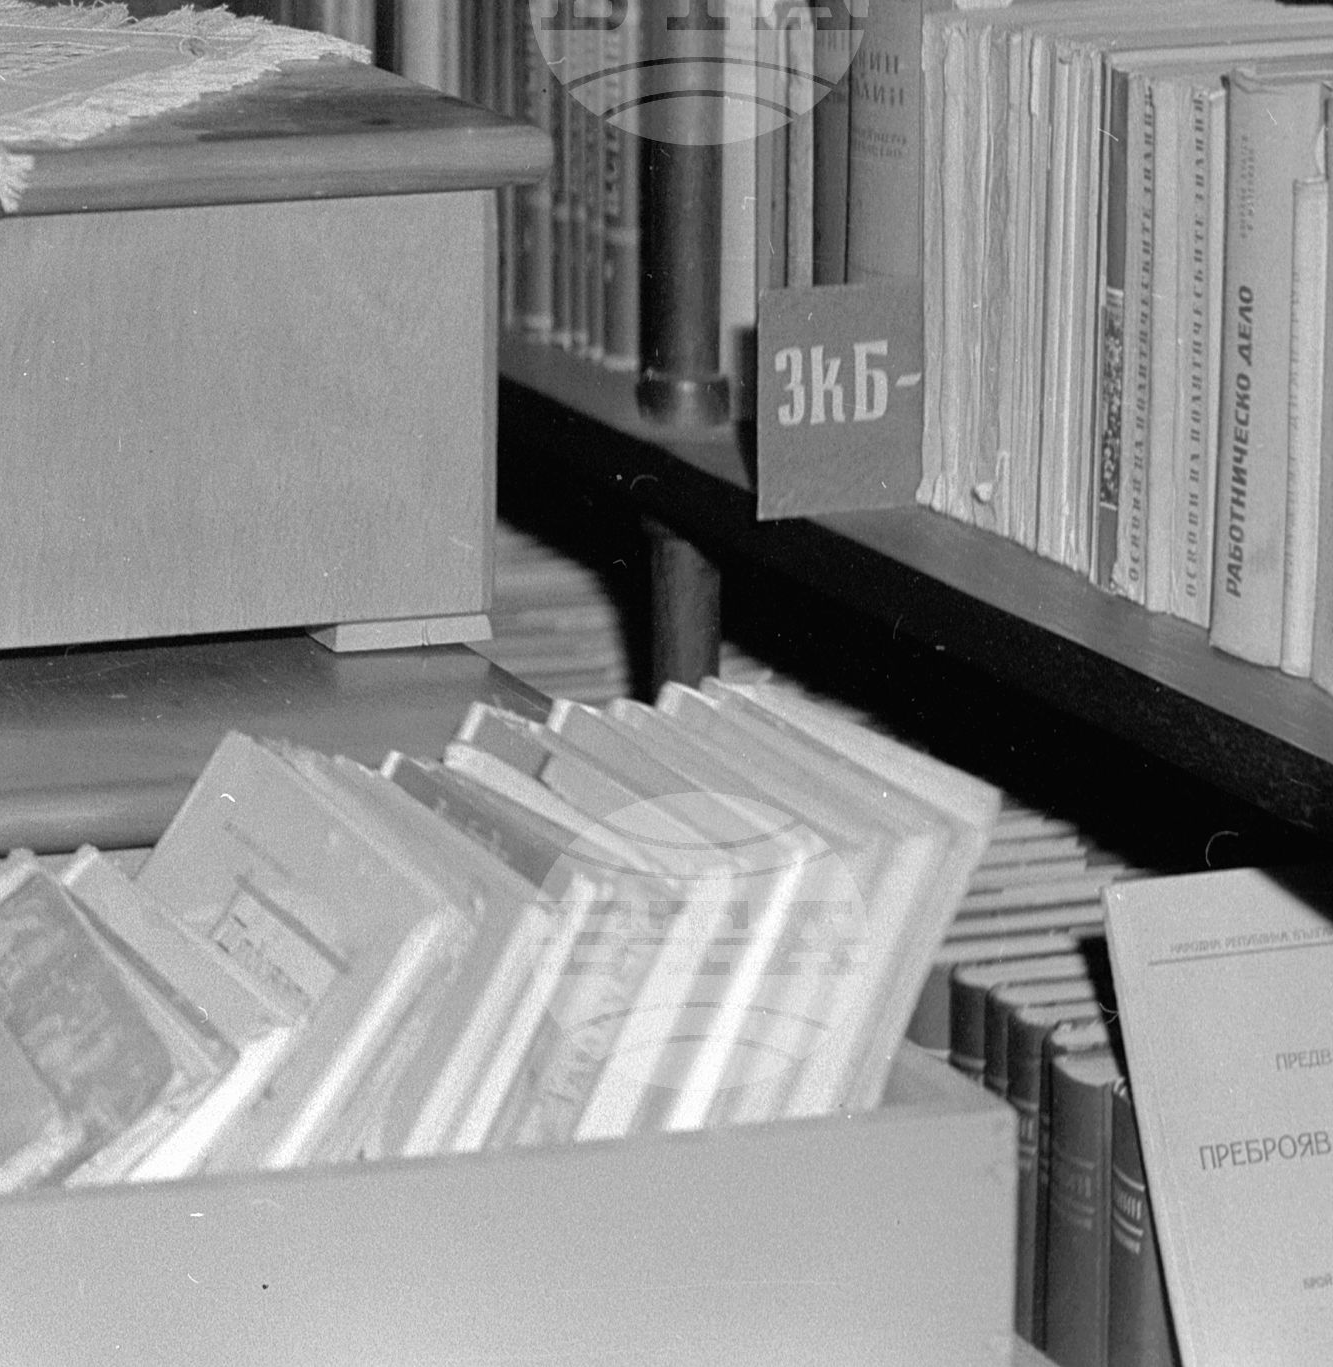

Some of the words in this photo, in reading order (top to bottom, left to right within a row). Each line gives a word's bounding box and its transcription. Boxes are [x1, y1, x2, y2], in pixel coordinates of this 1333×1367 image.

[1236, 284, 1254, 367] ДЕЛО
[1134, 439, 1144, 470] НА
[1190, 452, 1200, 483] НА
[1226, 372, 1251, 598] РАБОТНИЧЕСКО
[1275, 1047, 1332, 1071] ПРЕДВ
[1198, 1130, 1332, 1170] ПРЕБРОЯВ
